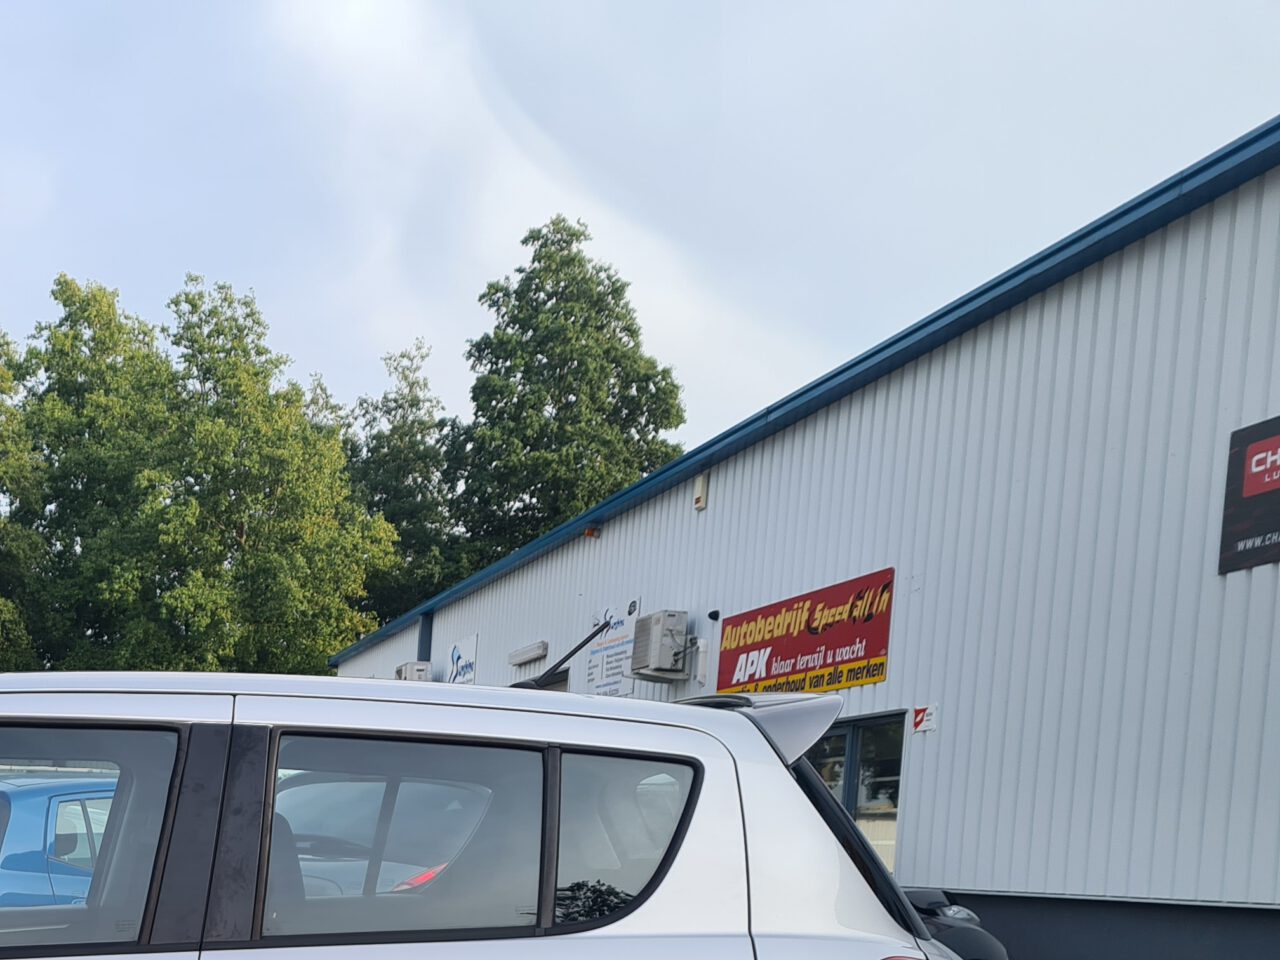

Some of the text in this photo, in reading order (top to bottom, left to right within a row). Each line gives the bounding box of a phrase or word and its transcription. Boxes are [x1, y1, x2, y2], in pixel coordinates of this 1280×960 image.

[1237, 531, 1280, 552] WWW.CH
[720, 600, 811, 651] Autobedrijf
[811, 593, 855, 633] Speed
[852, 587, 875, 620] all
[731, 637, 867, 685] APK klaar terwijl u wacht
[809, 672, 826, 689] van
[826, 666, 844, 687] alle
[846, 660, 885, 683] merken
